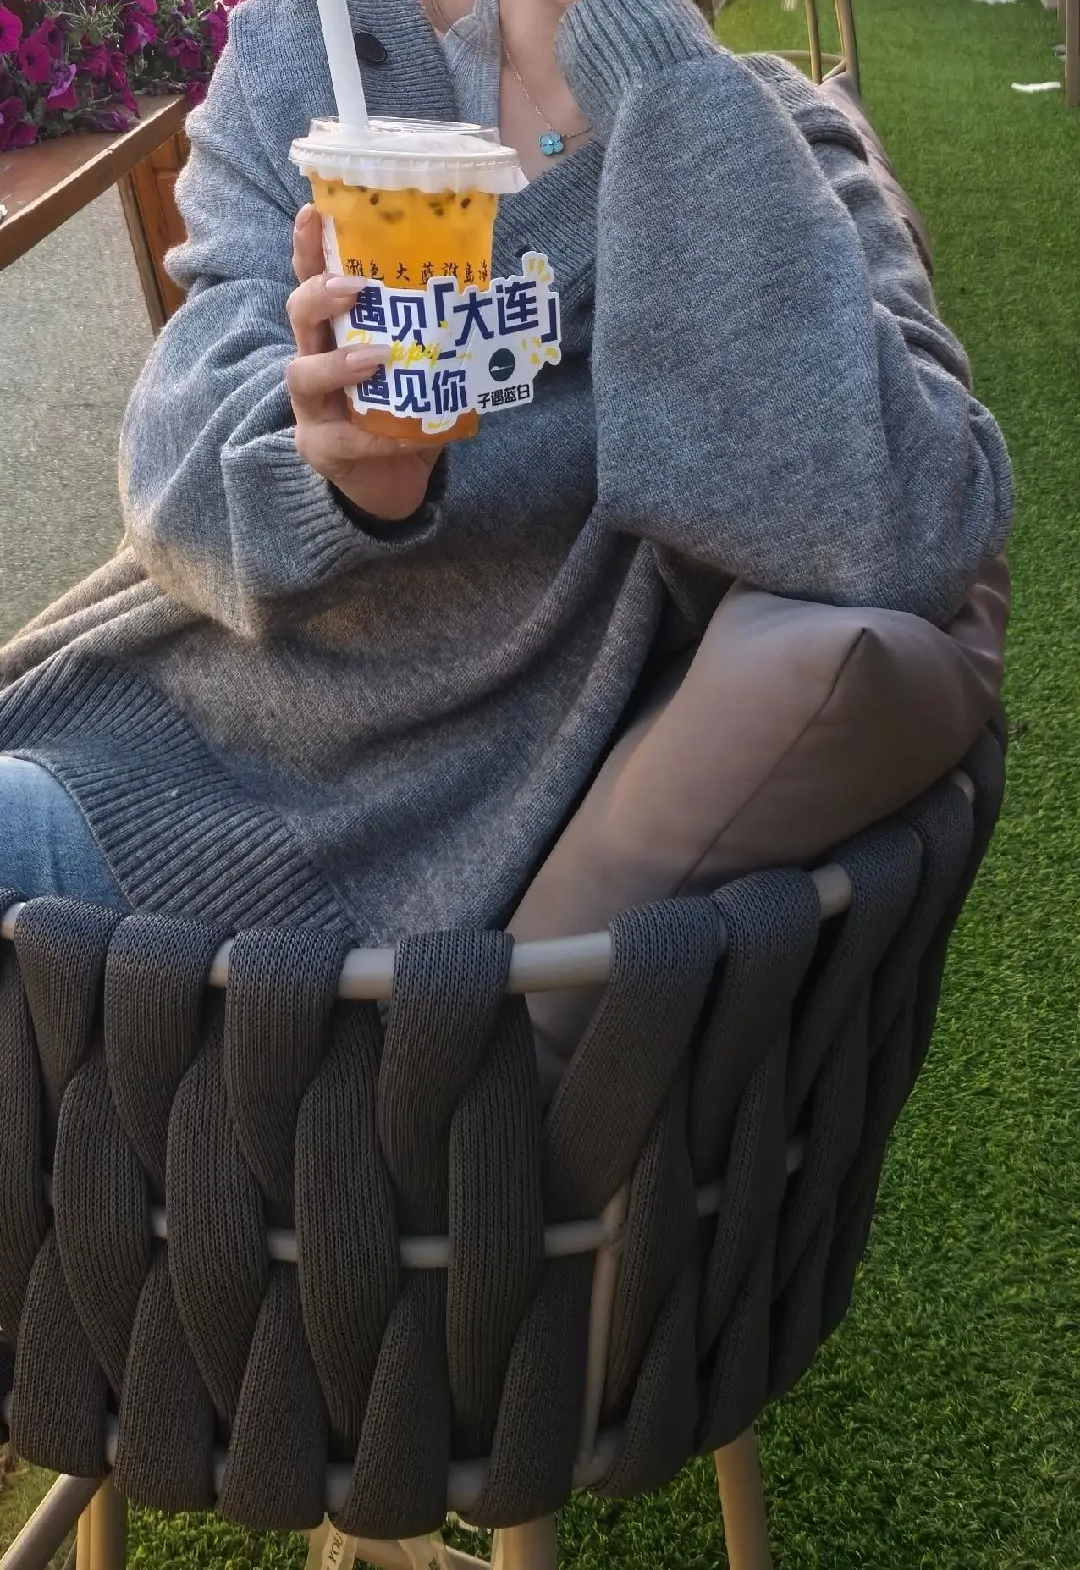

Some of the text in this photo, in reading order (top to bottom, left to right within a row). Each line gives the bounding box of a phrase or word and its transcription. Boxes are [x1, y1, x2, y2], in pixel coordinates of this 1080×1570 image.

[357, 364, 467, 414] 遇见你
[477, 385, 530, 409] 子遇蓝白
